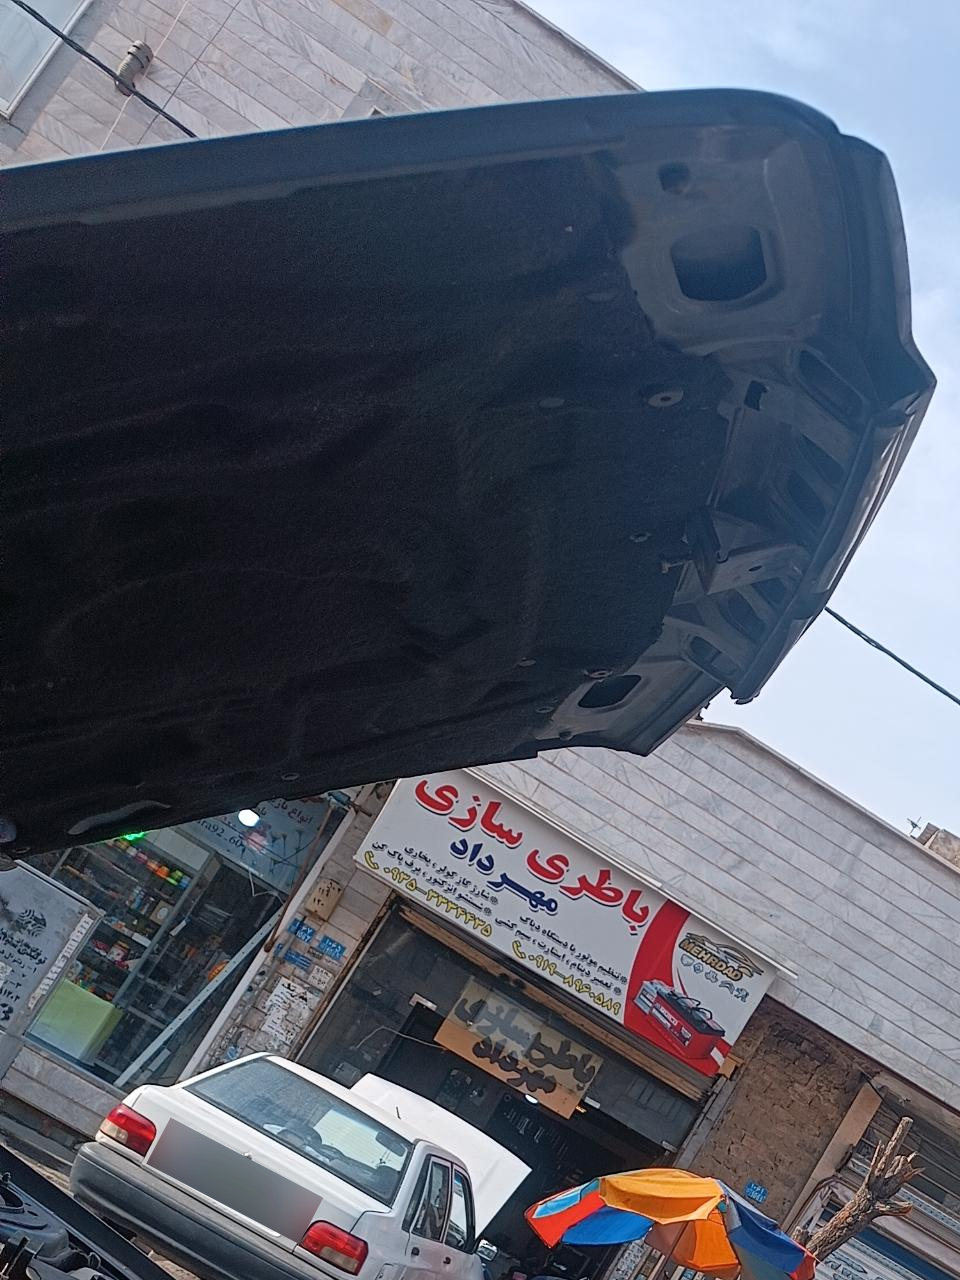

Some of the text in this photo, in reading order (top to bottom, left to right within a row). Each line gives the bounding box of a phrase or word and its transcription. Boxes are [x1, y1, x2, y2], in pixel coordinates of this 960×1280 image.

[414, 779, 650, 935] باطری سازی
[450, 838, 559, 914] مهرداد
[528, 954, 621, 1016] ۰۹۱۹-۸۹۶۰۵۸۹
[680, 937, 744, 982] MEHRDAD
[472, 1036, 557, 1094] مهرداد
